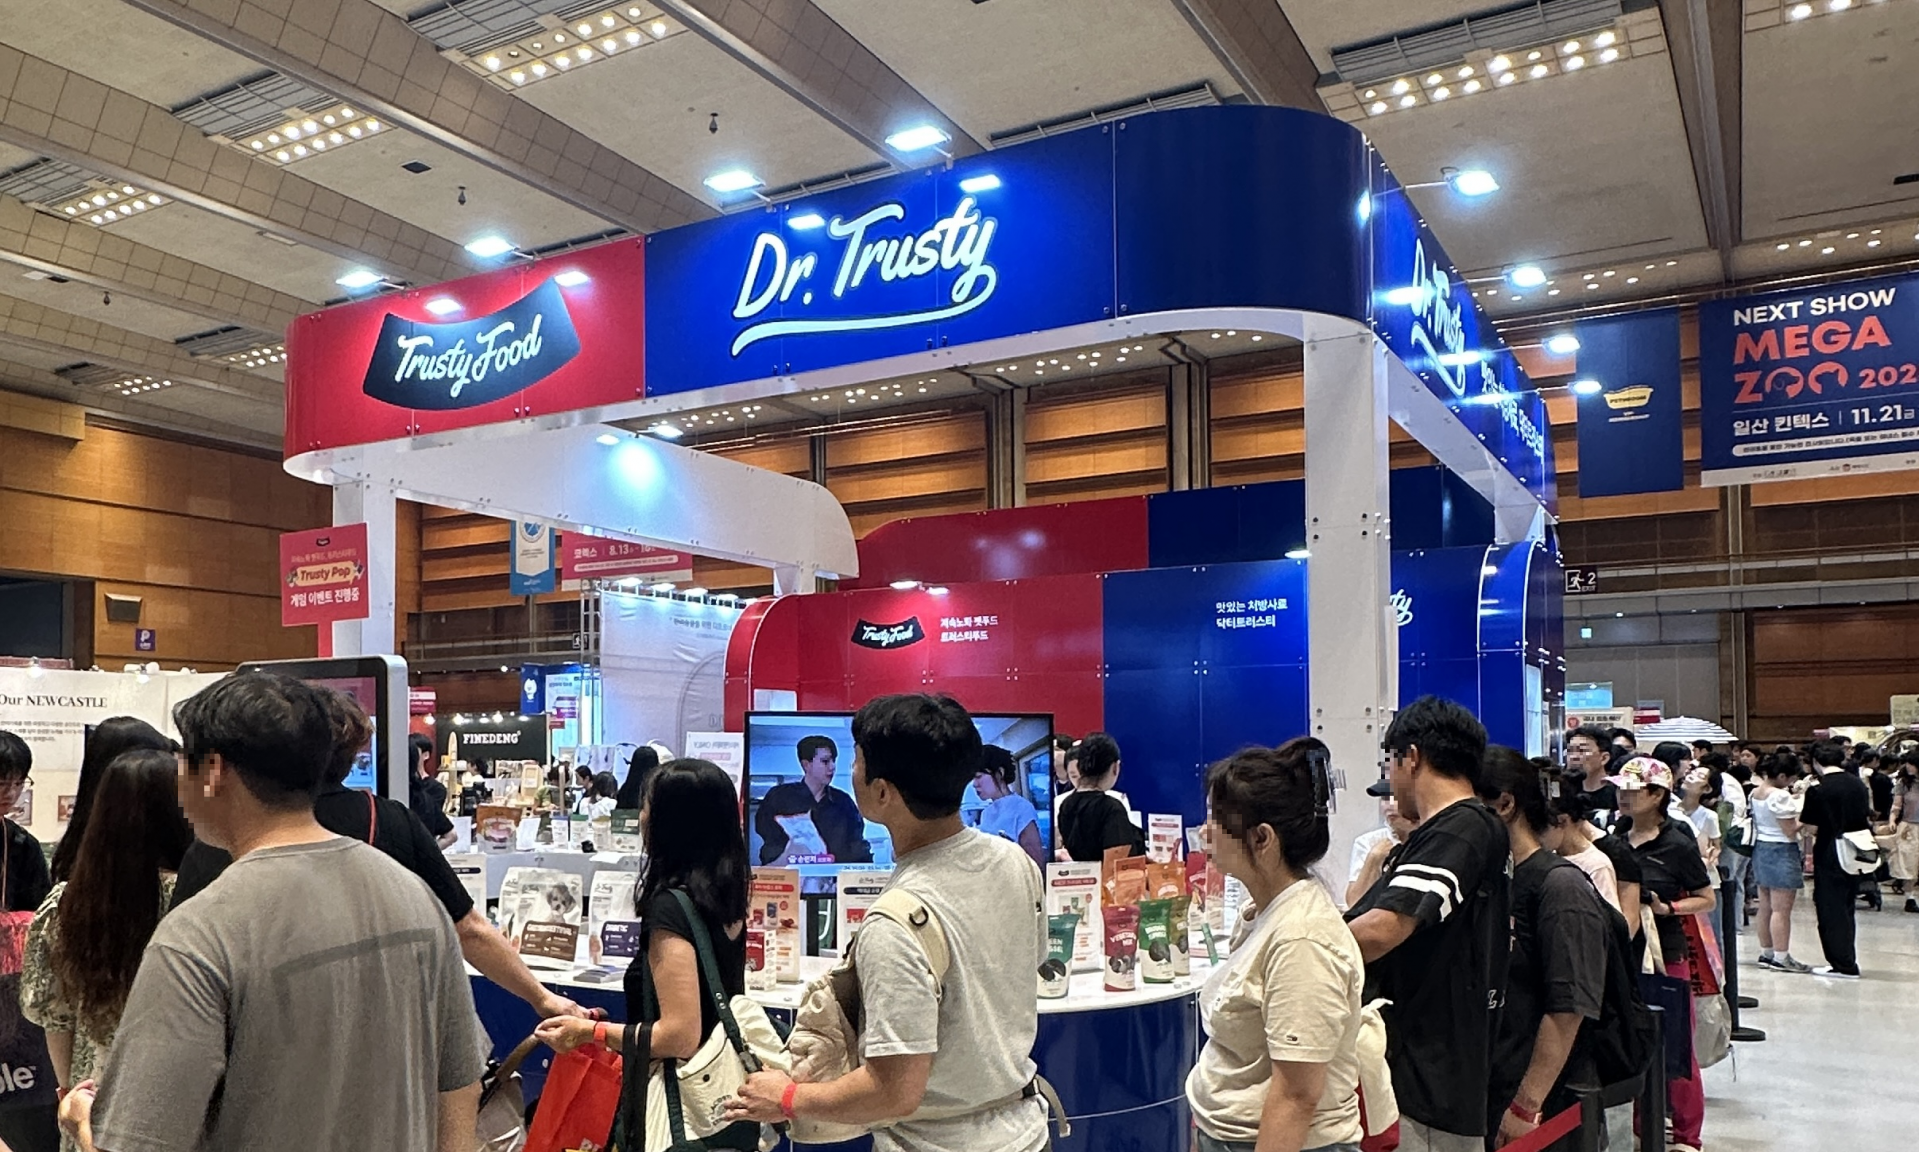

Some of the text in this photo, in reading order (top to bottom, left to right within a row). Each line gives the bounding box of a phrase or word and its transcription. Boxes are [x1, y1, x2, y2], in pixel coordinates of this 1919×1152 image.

[732, 197, 997, 318] Dr. Trusty
[1733, 287, 1897, 326] NEXT SHOW
[1733, 315, 1893, 365] MEGA
[394, 313, 542, 398] Trusty Food
[1858, 363, 1919, 389] 202
[1733, 419, 1769, 437] 일산
[1774, 412, 1830, 433] 킨텍스
[300, 566, 351, 581] Trusty Pop
[1587, 573, 1596, 585] 2
[308, 590, 334, 606] 이벤트
[1215, 601, 1246, 614] 맛있는
[1216, 615, 1276, 629] 닥터트러스티
[862, 625, 891, 647] Trusty
[26, 695, 108, 708] NEWCASTLE
[462, 732, 519, 745] FINEDENG
